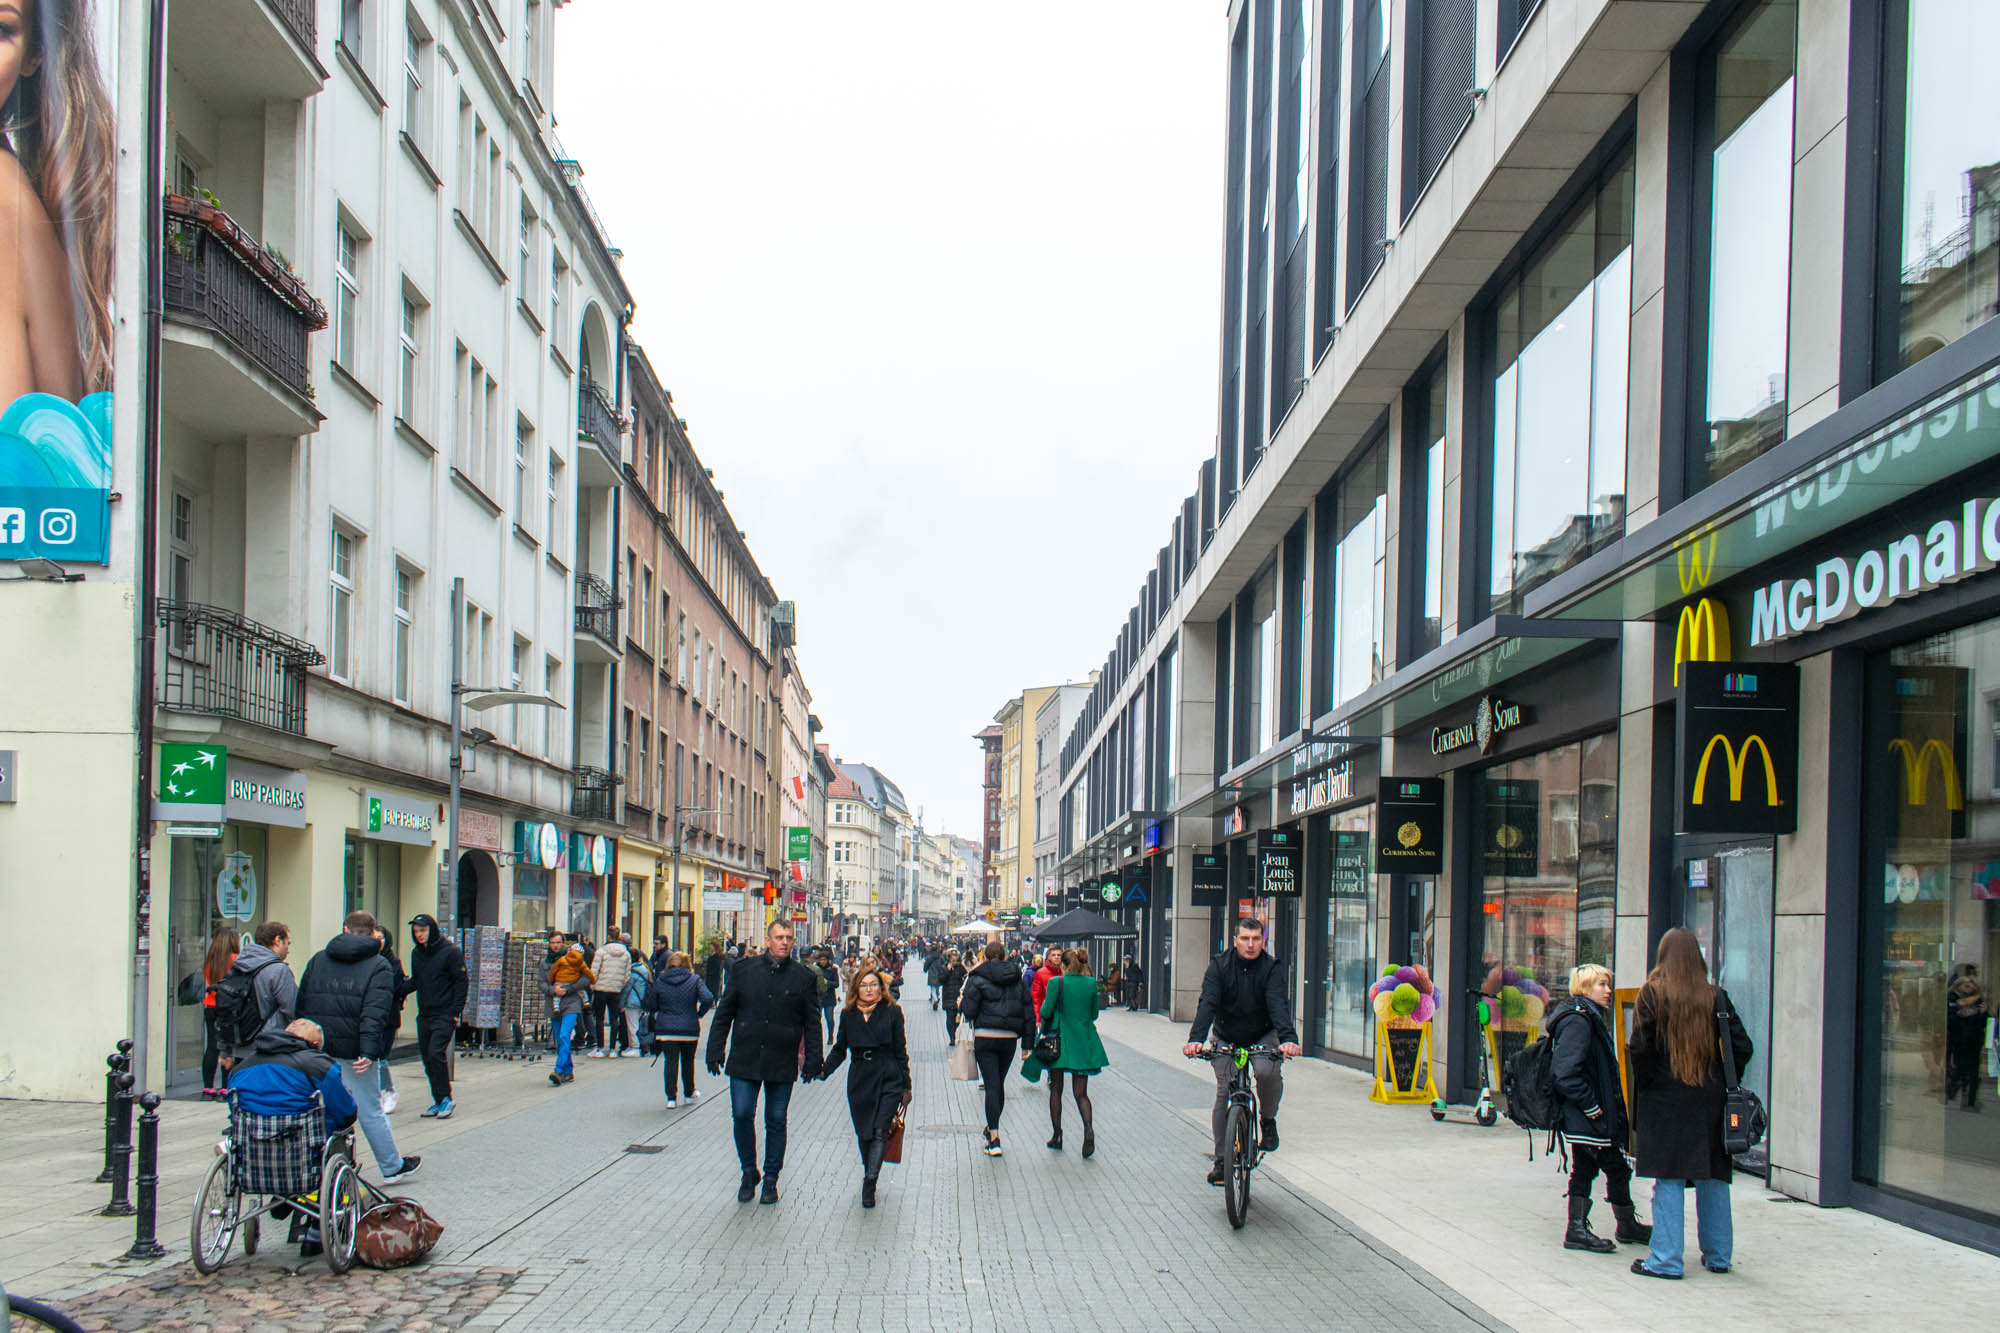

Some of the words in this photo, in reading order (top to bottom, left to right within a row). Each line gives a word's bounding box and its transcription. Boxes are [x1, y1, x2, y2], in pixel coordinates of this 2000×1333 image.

[1431, 723, 1474, 755] CUKIERNIA
[1493, 700, 1521, 733] SOWA
[231, 779, 257, 801] BNP
[258, 783, 305, 809] PARIBAS
[1291, 782, 1306, 815] Jean
[1307, 771, 1327, 810] Louis
[1327, 760, 1350, 804] David
[384, 808, 401, 826] BNP
[402, 811, 432, 832] PARIBAS
[1262, 852, 1289, 866] Jean
[1263, 866, 1294, 879] Louis
[1262, 878, 1295, 892] David
